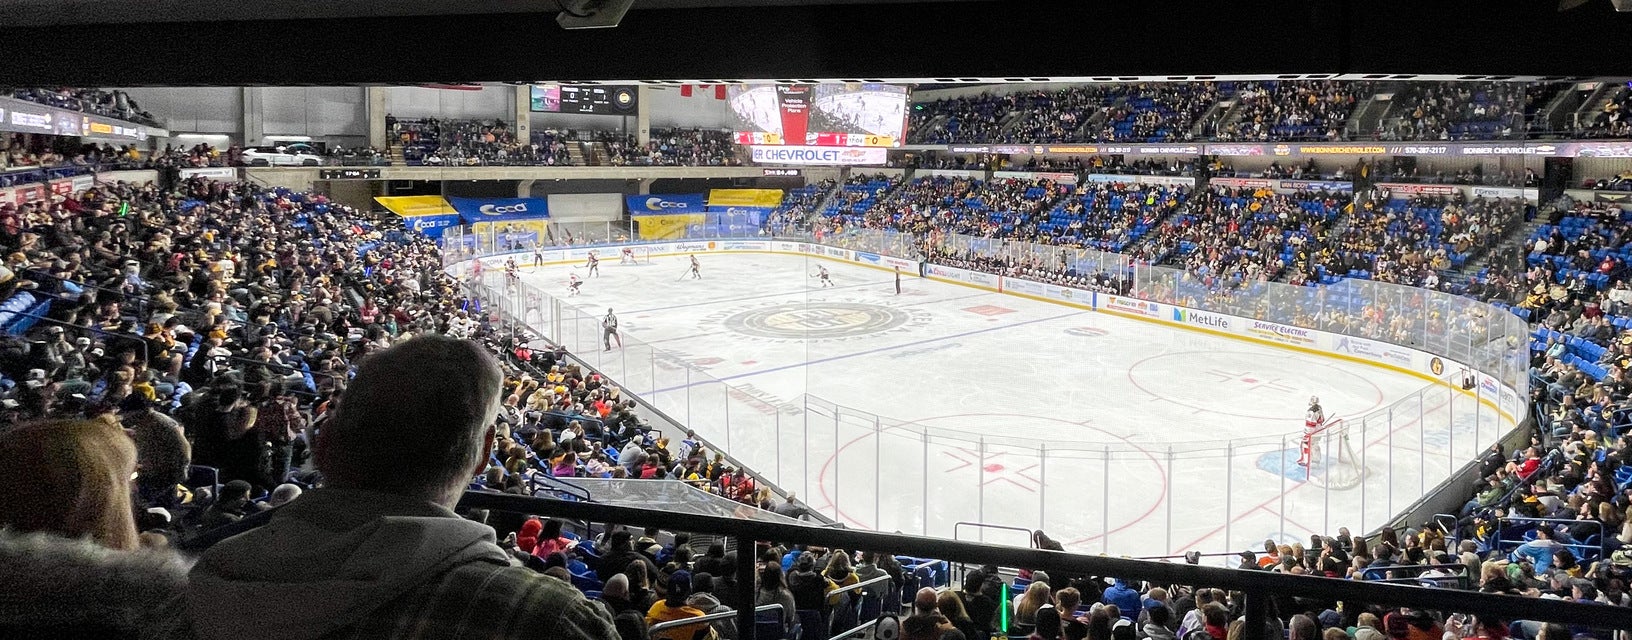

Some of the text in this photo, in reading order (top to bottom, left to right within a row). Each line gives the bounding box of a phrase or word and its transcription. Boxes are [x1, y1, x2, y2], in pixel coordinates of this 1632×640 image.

[872, 137, 878, 145] 0
[765, 149, 841, 161] CHEVROLET
[1189, 312, 1228, 329] MetLife
[1253, 321, 1278, 332] SERVICE
[1279, 326, 1308, 337] ELECTRIC
